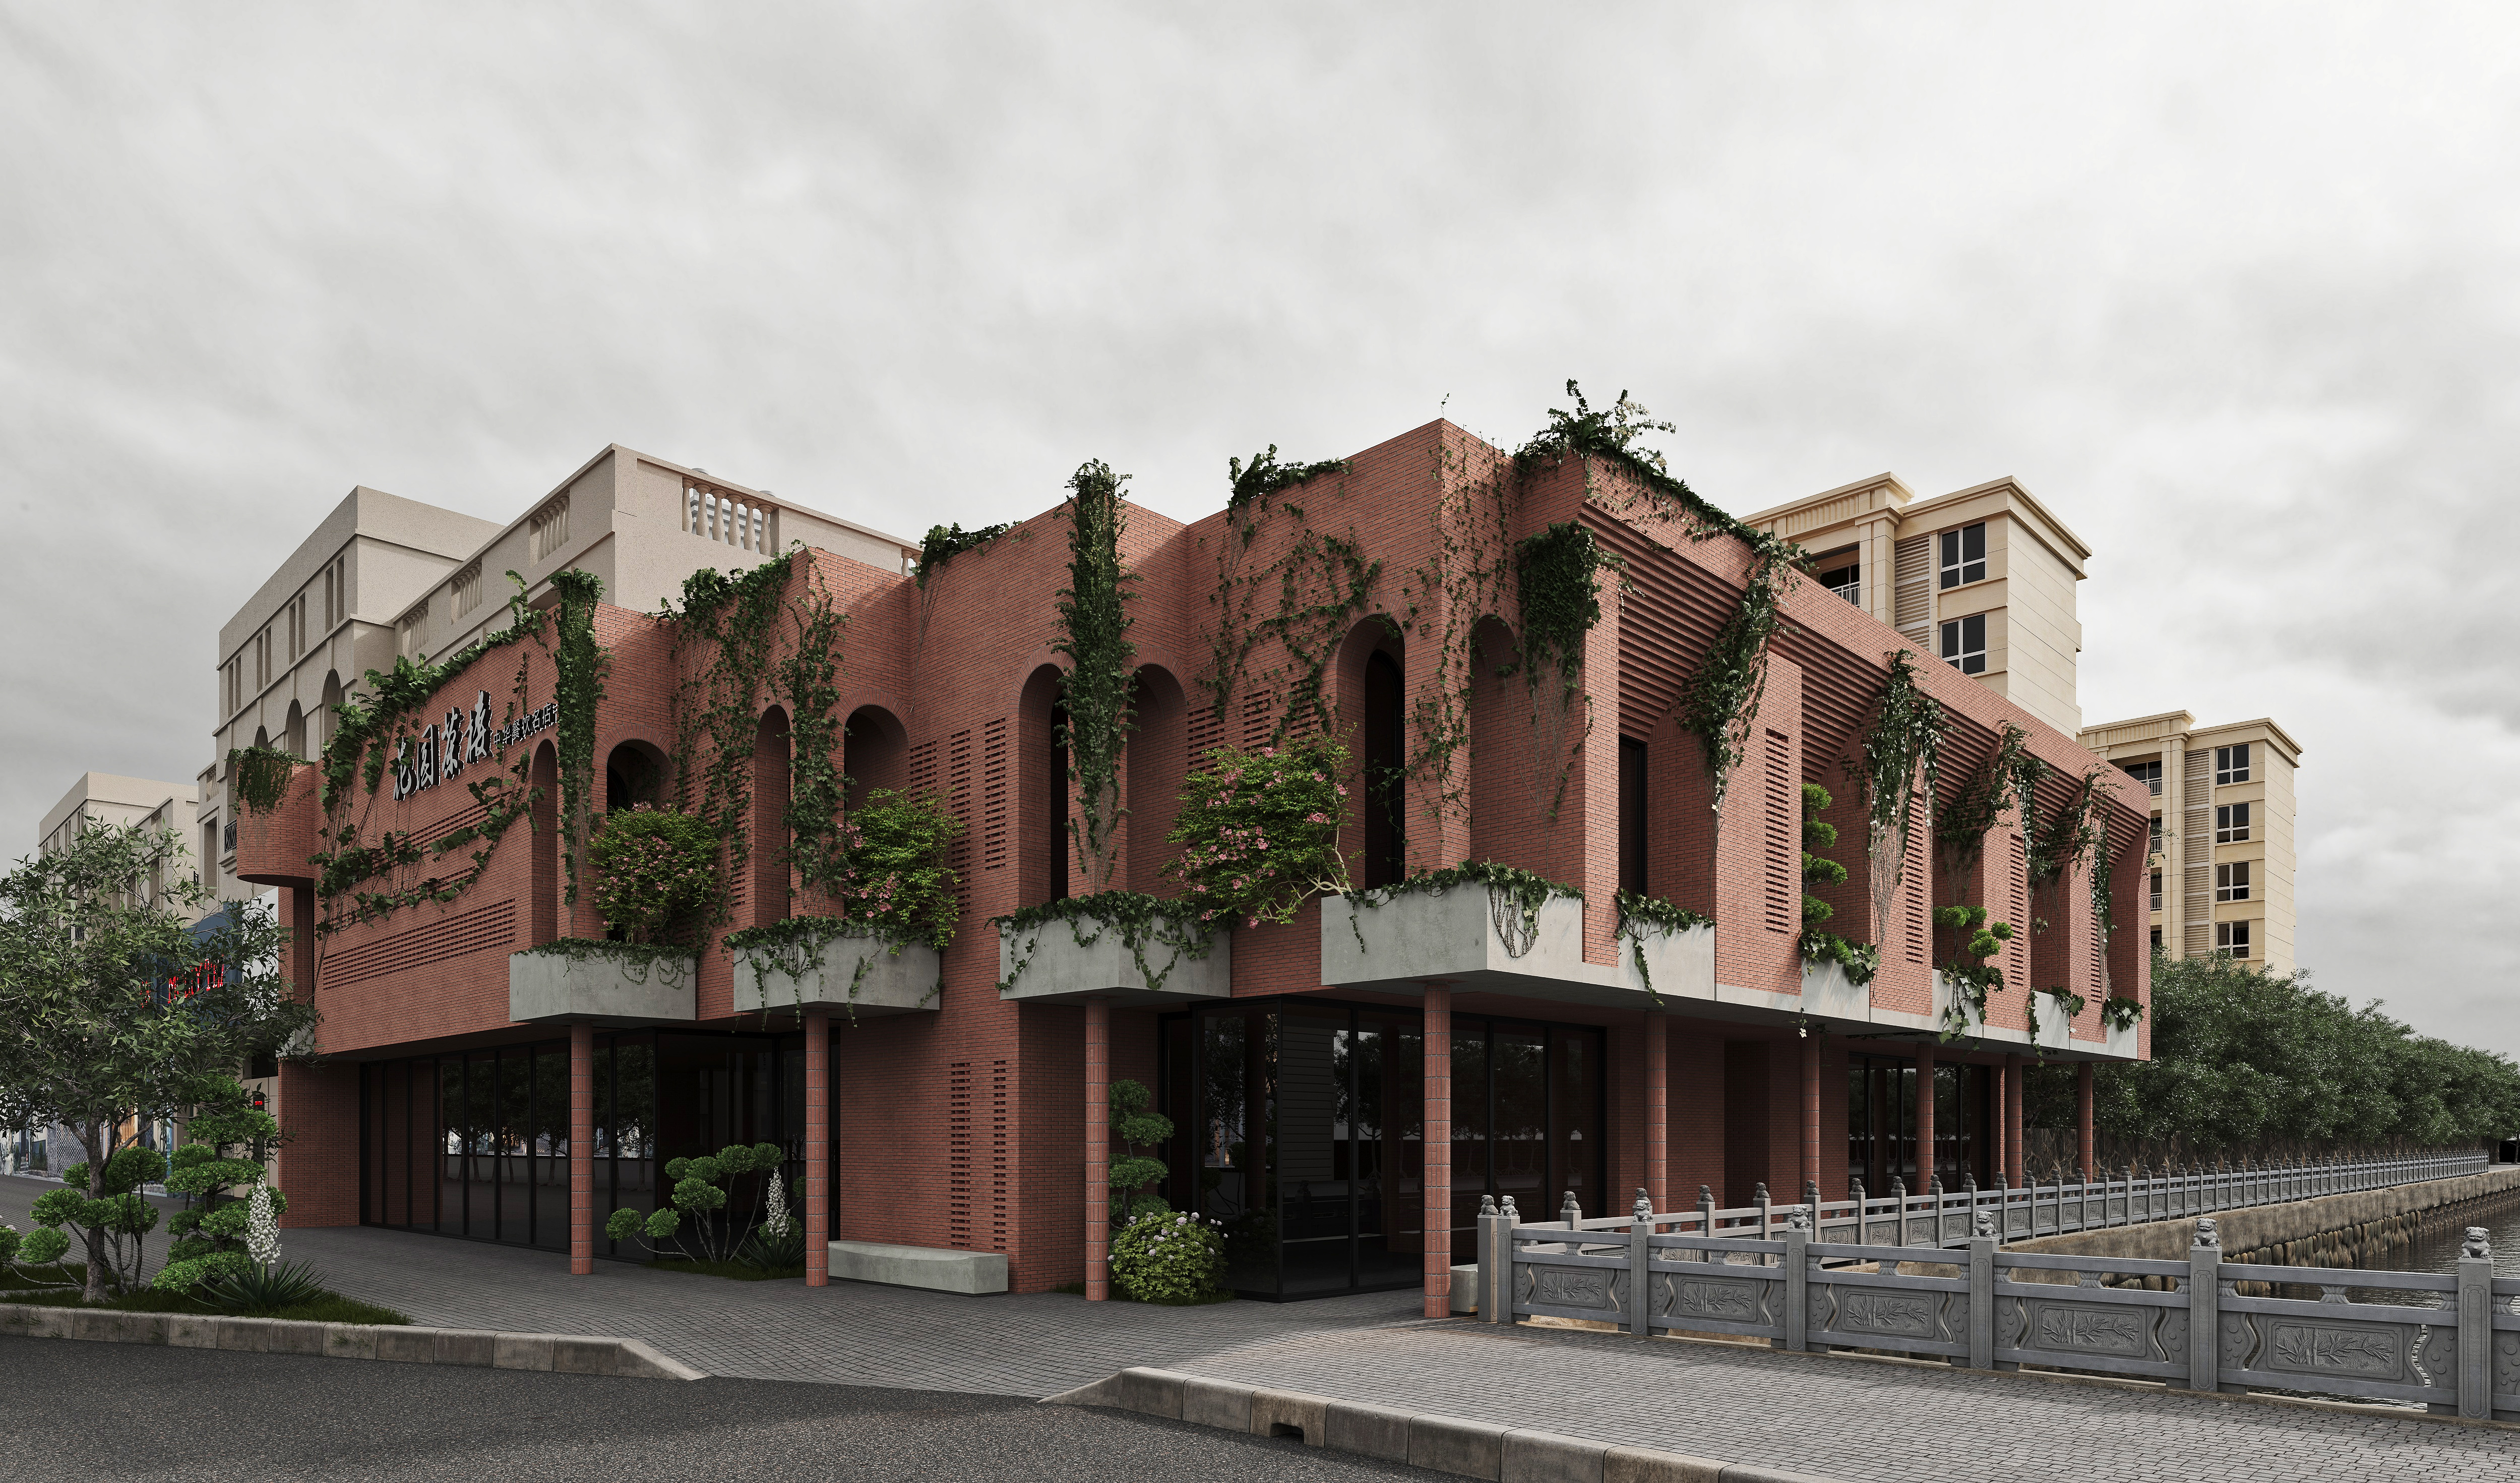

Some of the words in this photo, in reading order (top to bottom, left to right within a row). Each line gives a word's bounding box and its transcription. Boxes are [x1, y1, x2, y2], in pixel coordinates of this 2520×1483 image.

[494, 702, 551, 749] 中华餐饮名店
